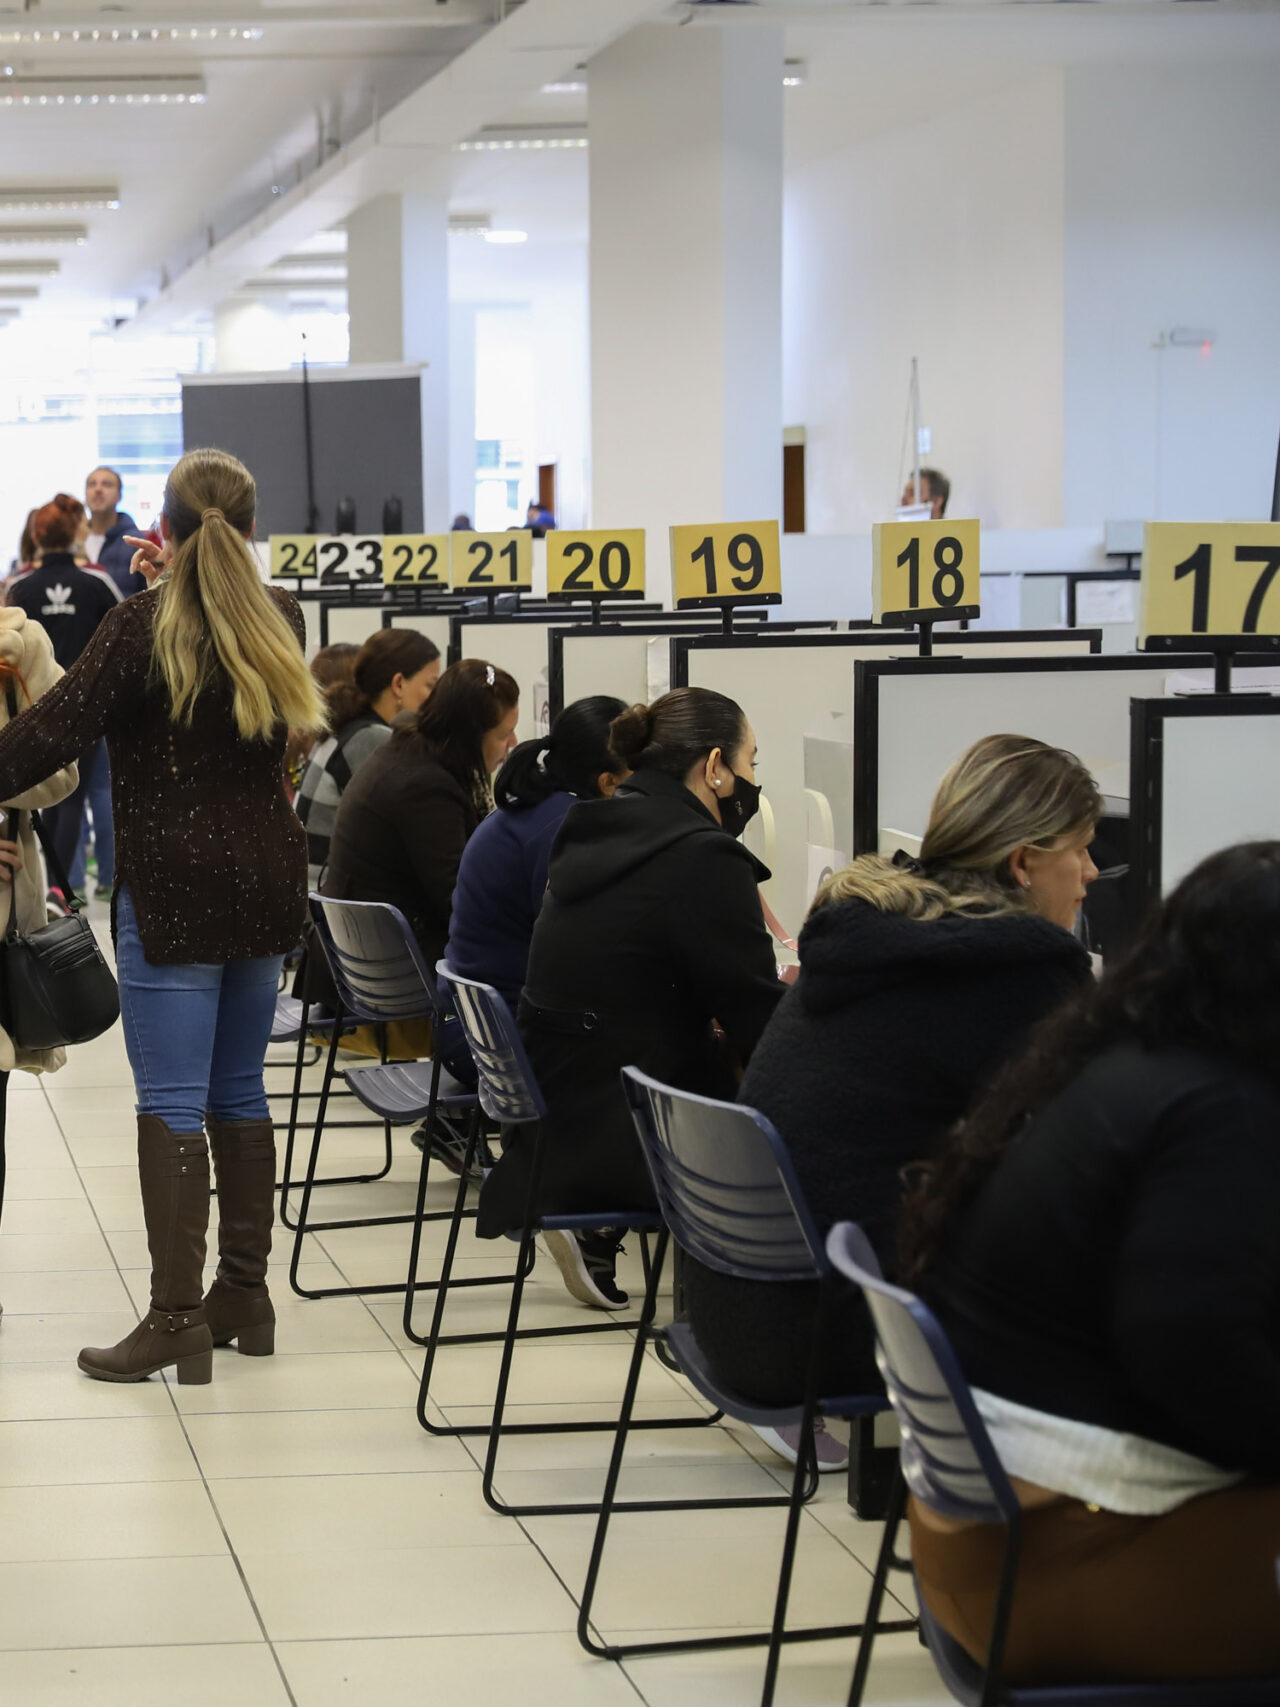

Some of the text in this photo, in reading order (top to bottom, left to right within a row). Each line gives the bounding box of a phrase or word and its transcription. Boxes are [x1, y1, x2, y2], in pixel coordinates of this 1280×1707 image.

[280, 543, 317, 574] 24
[321, 541, 382, 581] 23
[393, 544, 438, 581] 22
[468, 540, 518, 582] 21
[561, 541, 631, 591] 20
[690, 533, 765, 594] 19
[897, 537, 965, 608] 18
[1174, 544, 1280, 633] 17
